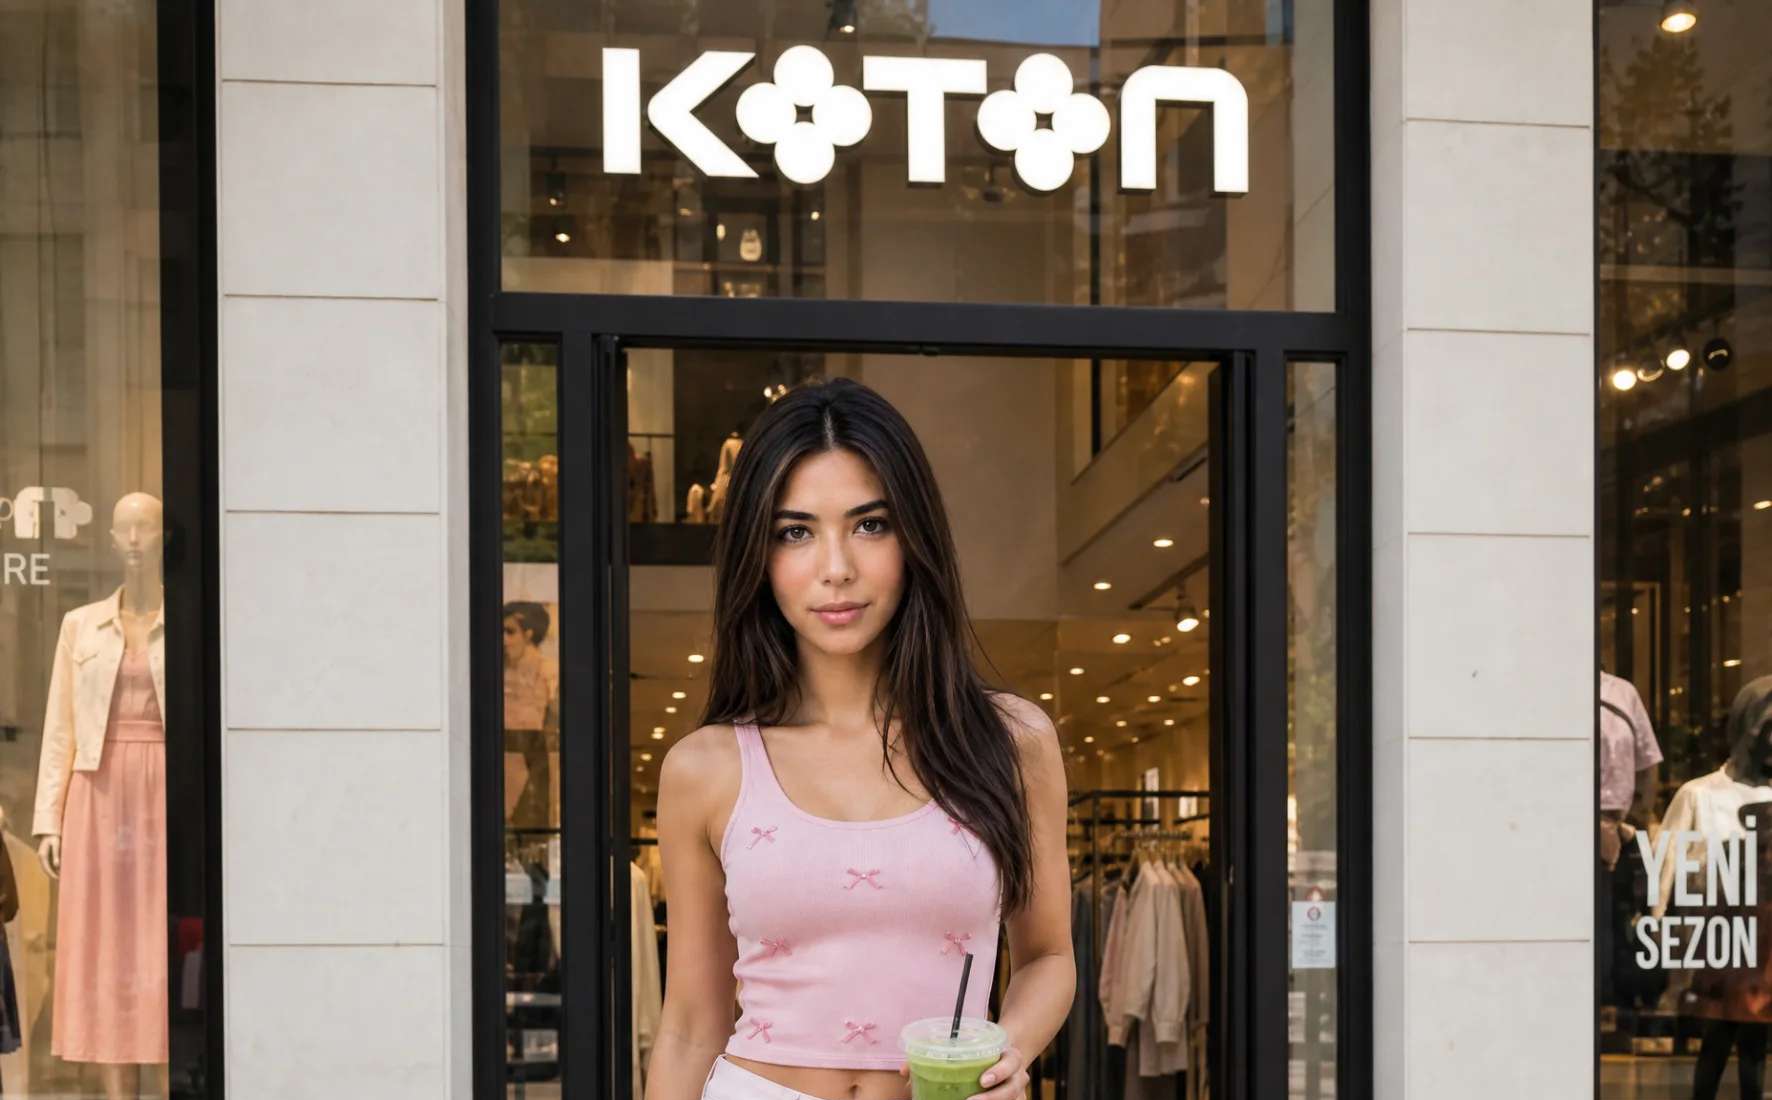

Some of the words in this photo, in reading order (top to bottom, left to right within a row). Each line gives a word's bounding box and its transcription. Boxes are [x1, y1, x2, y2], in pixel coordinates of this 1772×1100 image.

[602, 44, 1249, 194] KOTON
[1635, 814, 1758, 907] YENİ
[1635, 915, 1758, 970] SEZON
